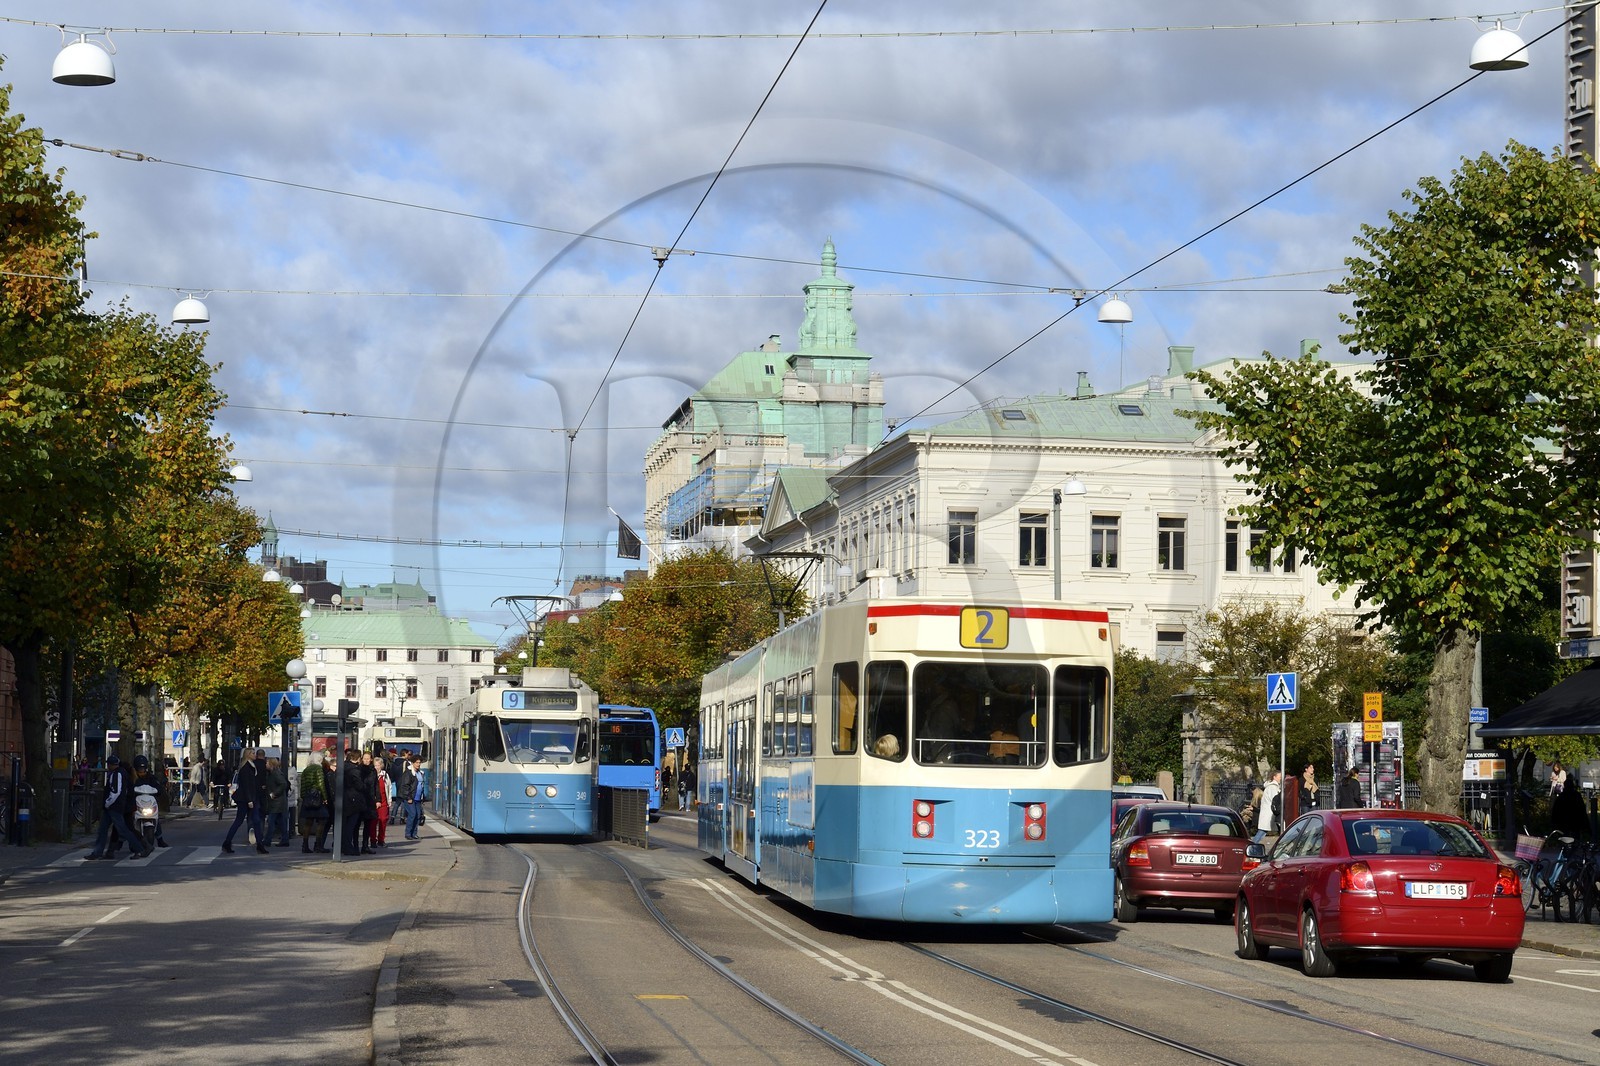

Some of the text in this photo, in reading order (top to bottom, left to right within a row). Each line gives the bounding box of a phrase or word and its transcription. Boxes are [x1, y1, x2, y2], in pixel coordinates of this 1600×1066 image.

[1575, 79, 1592, 110] 10
[1572, 595, 1590, 625] 30
[974, 611, 994, 644] 2
[509, 692, 519, 708] 9
[611, 725, 621, 733] 16
[487, 790, 501, 799] 349
[576, 791, 587, 800] 349
[964, 830, 1001, 849] 323
[1177, 854, 1216, 864] PYZ 880
[1412, 884, 1434, 895] LLP
[1444, 885, 1464, 896] 158
